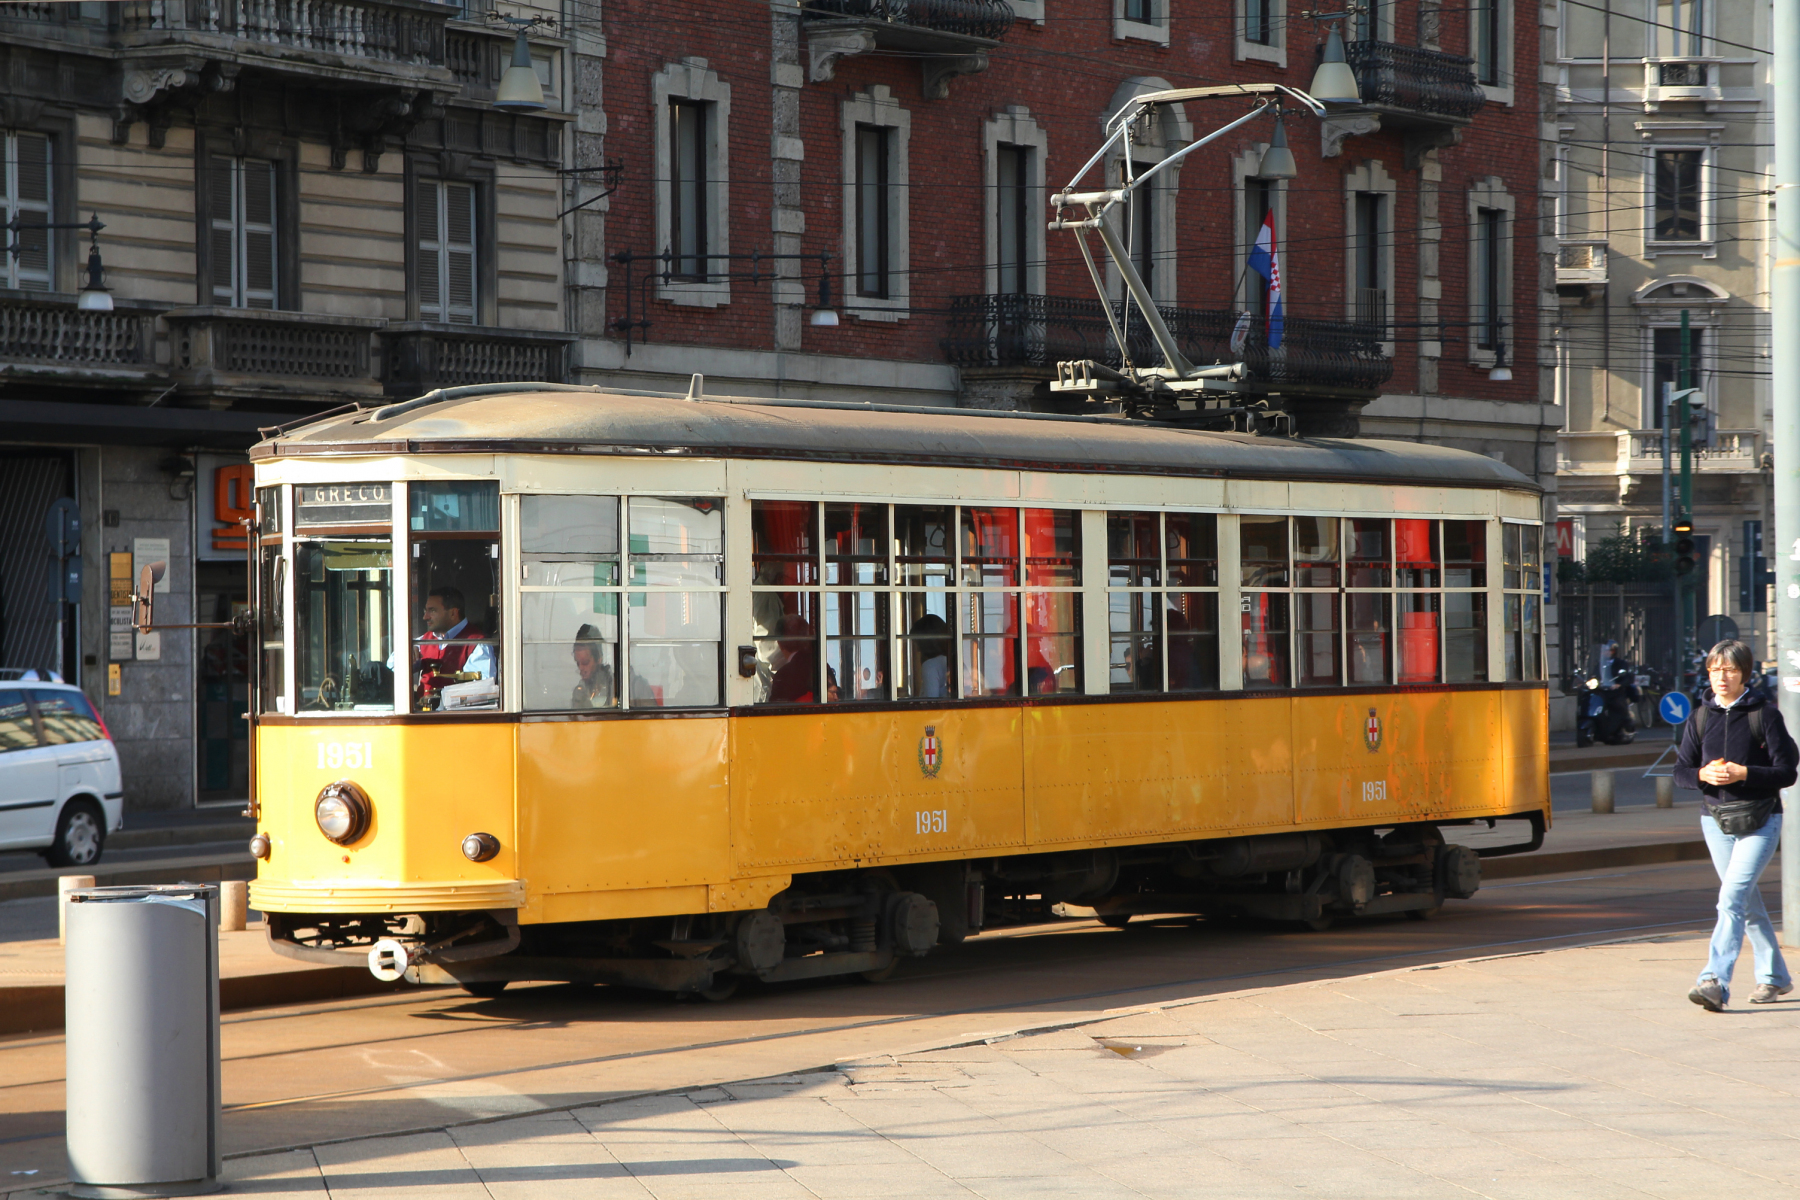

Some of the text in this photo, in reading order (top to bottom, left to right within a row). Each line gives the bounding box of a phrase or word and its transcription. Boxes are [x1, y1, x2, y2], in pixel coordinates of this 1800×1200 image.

[315, 484, 384, 502] GRECO
[110, 617, 132, 626] OCULISTA
[316, 742, 373, 769] 1951
[1362, 780, 1387, 802] 1951
[916, 809, 948, 834] 1951
